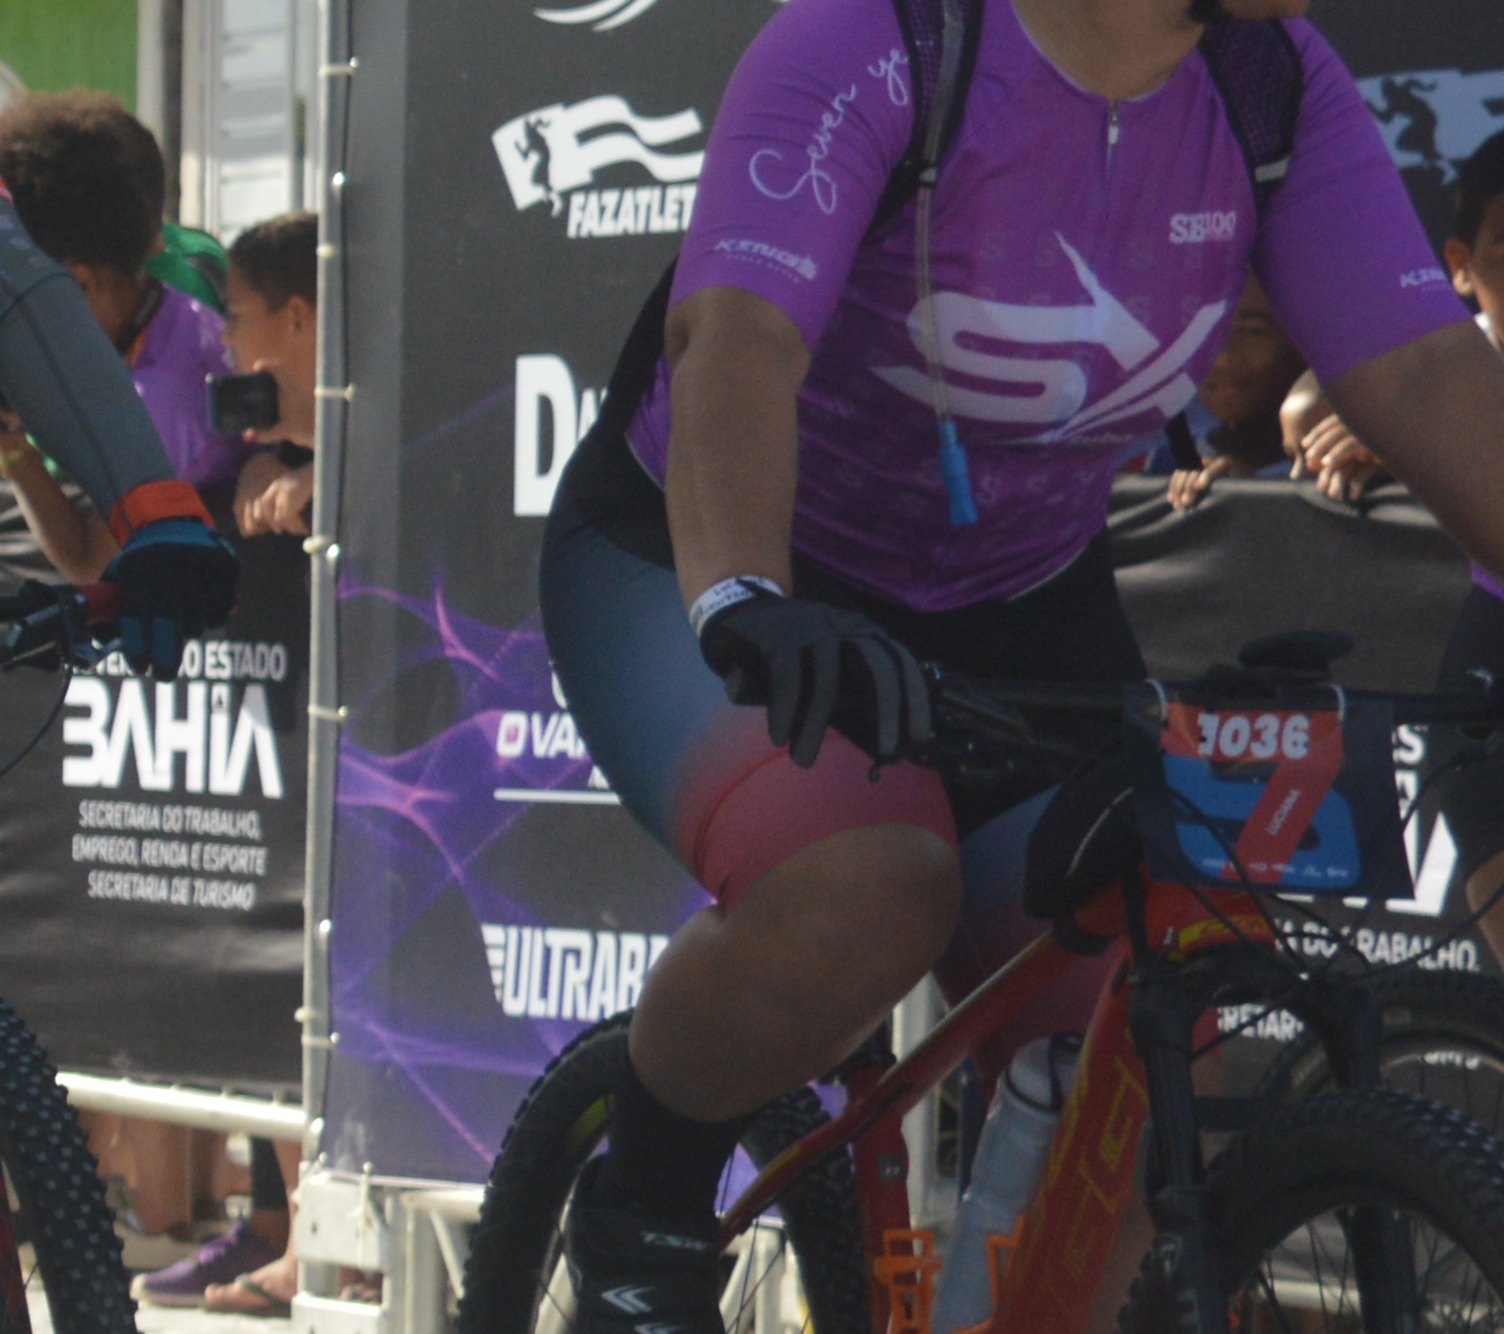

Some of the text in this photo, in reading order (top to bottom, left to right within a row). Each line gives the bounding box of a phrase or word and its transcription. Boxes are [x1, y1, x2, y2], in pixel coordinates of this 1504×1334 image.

[205, 641, 287, 681] ESTADO
[62, 676, 284, 799] BAHIA
[1197, 712, 1310, 759] 1036
[79, 799, 161, 831] SECRETARIA
[162, 805, 183, 833] DO
[141, 838, 188, 868] RENDA
[190, 842, 202, 870] E
[203, 843, 268, 876] ESPORTE
[88, 870, 256, 911] SECRETARIA DE TURISMO
